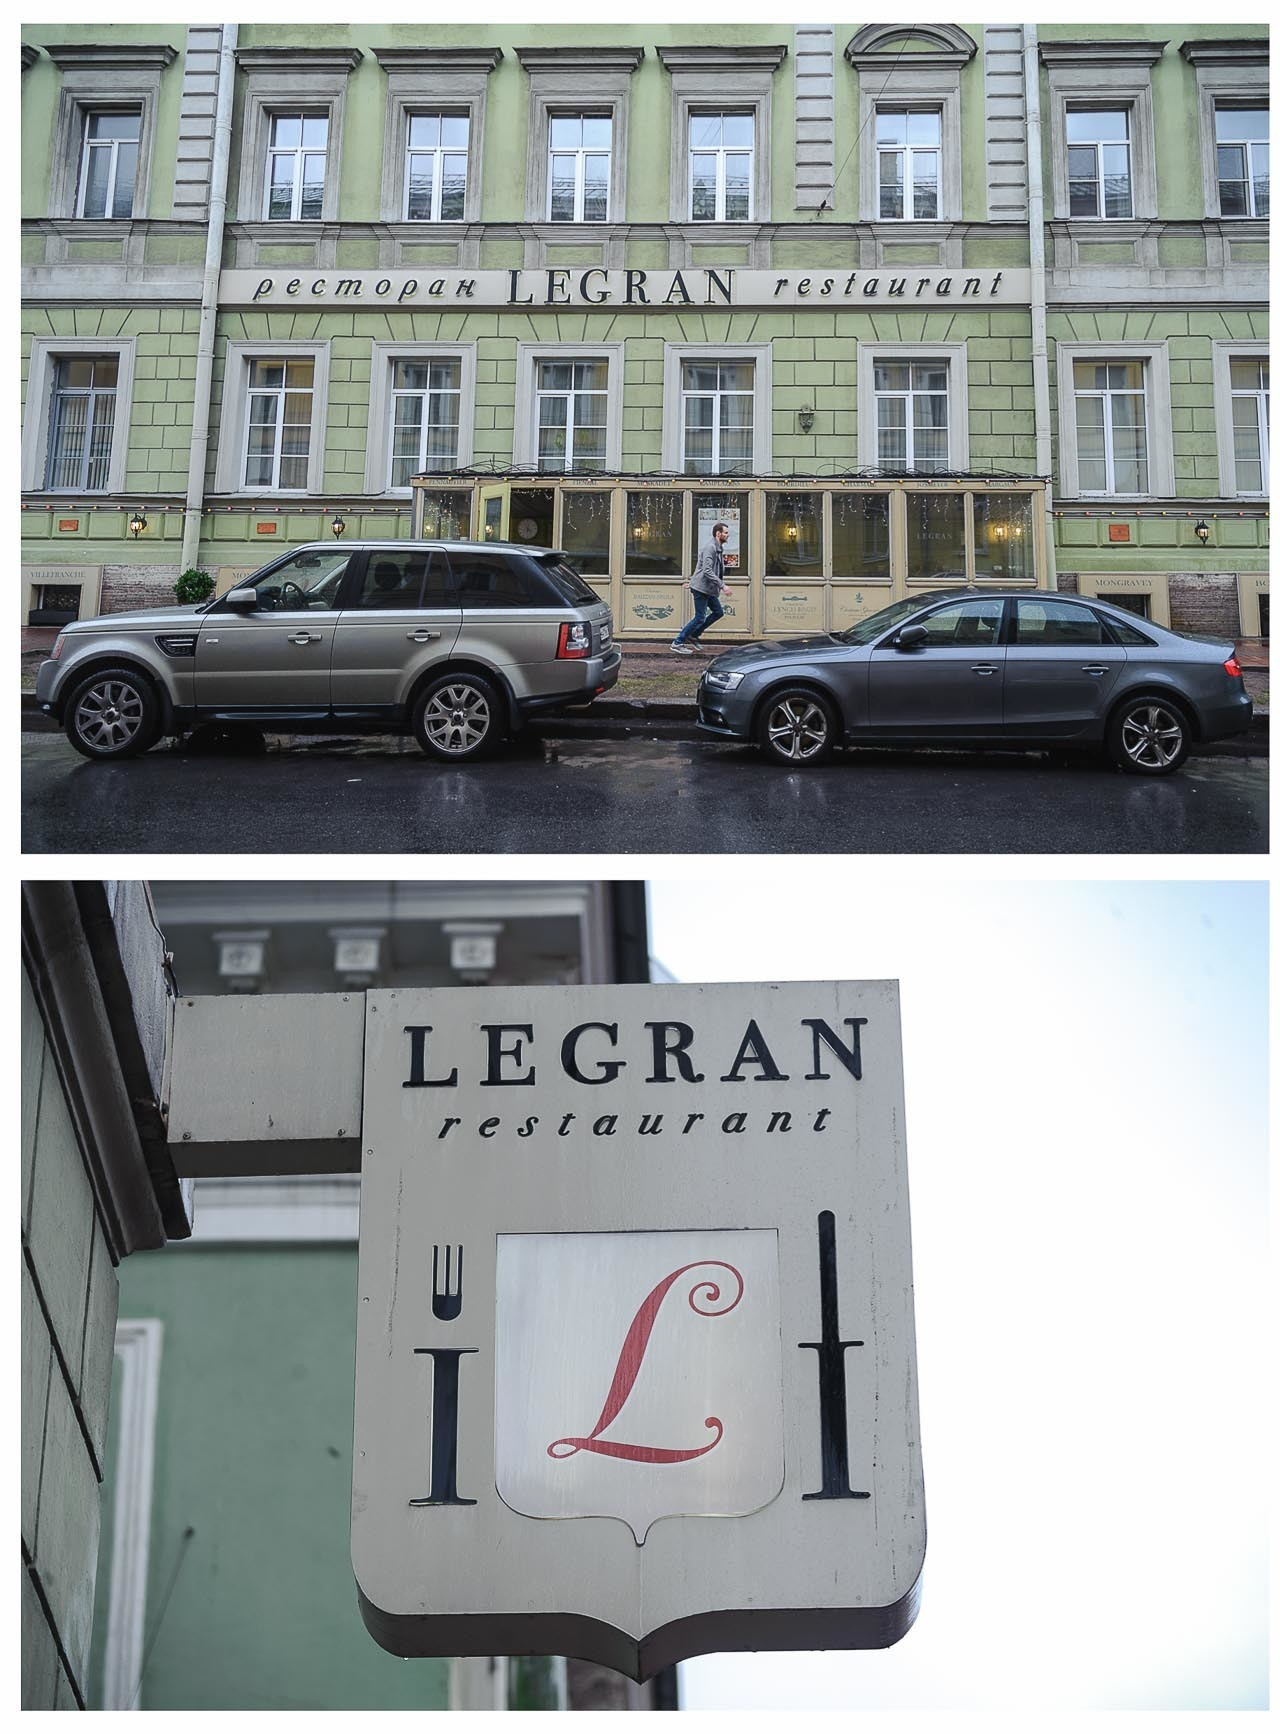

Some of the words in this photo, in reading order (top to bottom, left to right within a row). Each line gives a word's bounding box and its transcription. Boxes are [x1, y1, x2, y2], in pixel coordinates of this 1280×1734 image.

[252, 273, 477, 301] ресторан
[507, 269, 735, 304] LEGRAN
[774, 273, 1003, 297] restaurant
[1095, 578, 1153, 587] MONGRAVEY
[402, 1017, 868, 1089] LEGRAN
[438, 1107, 833, 1139] restaurant
